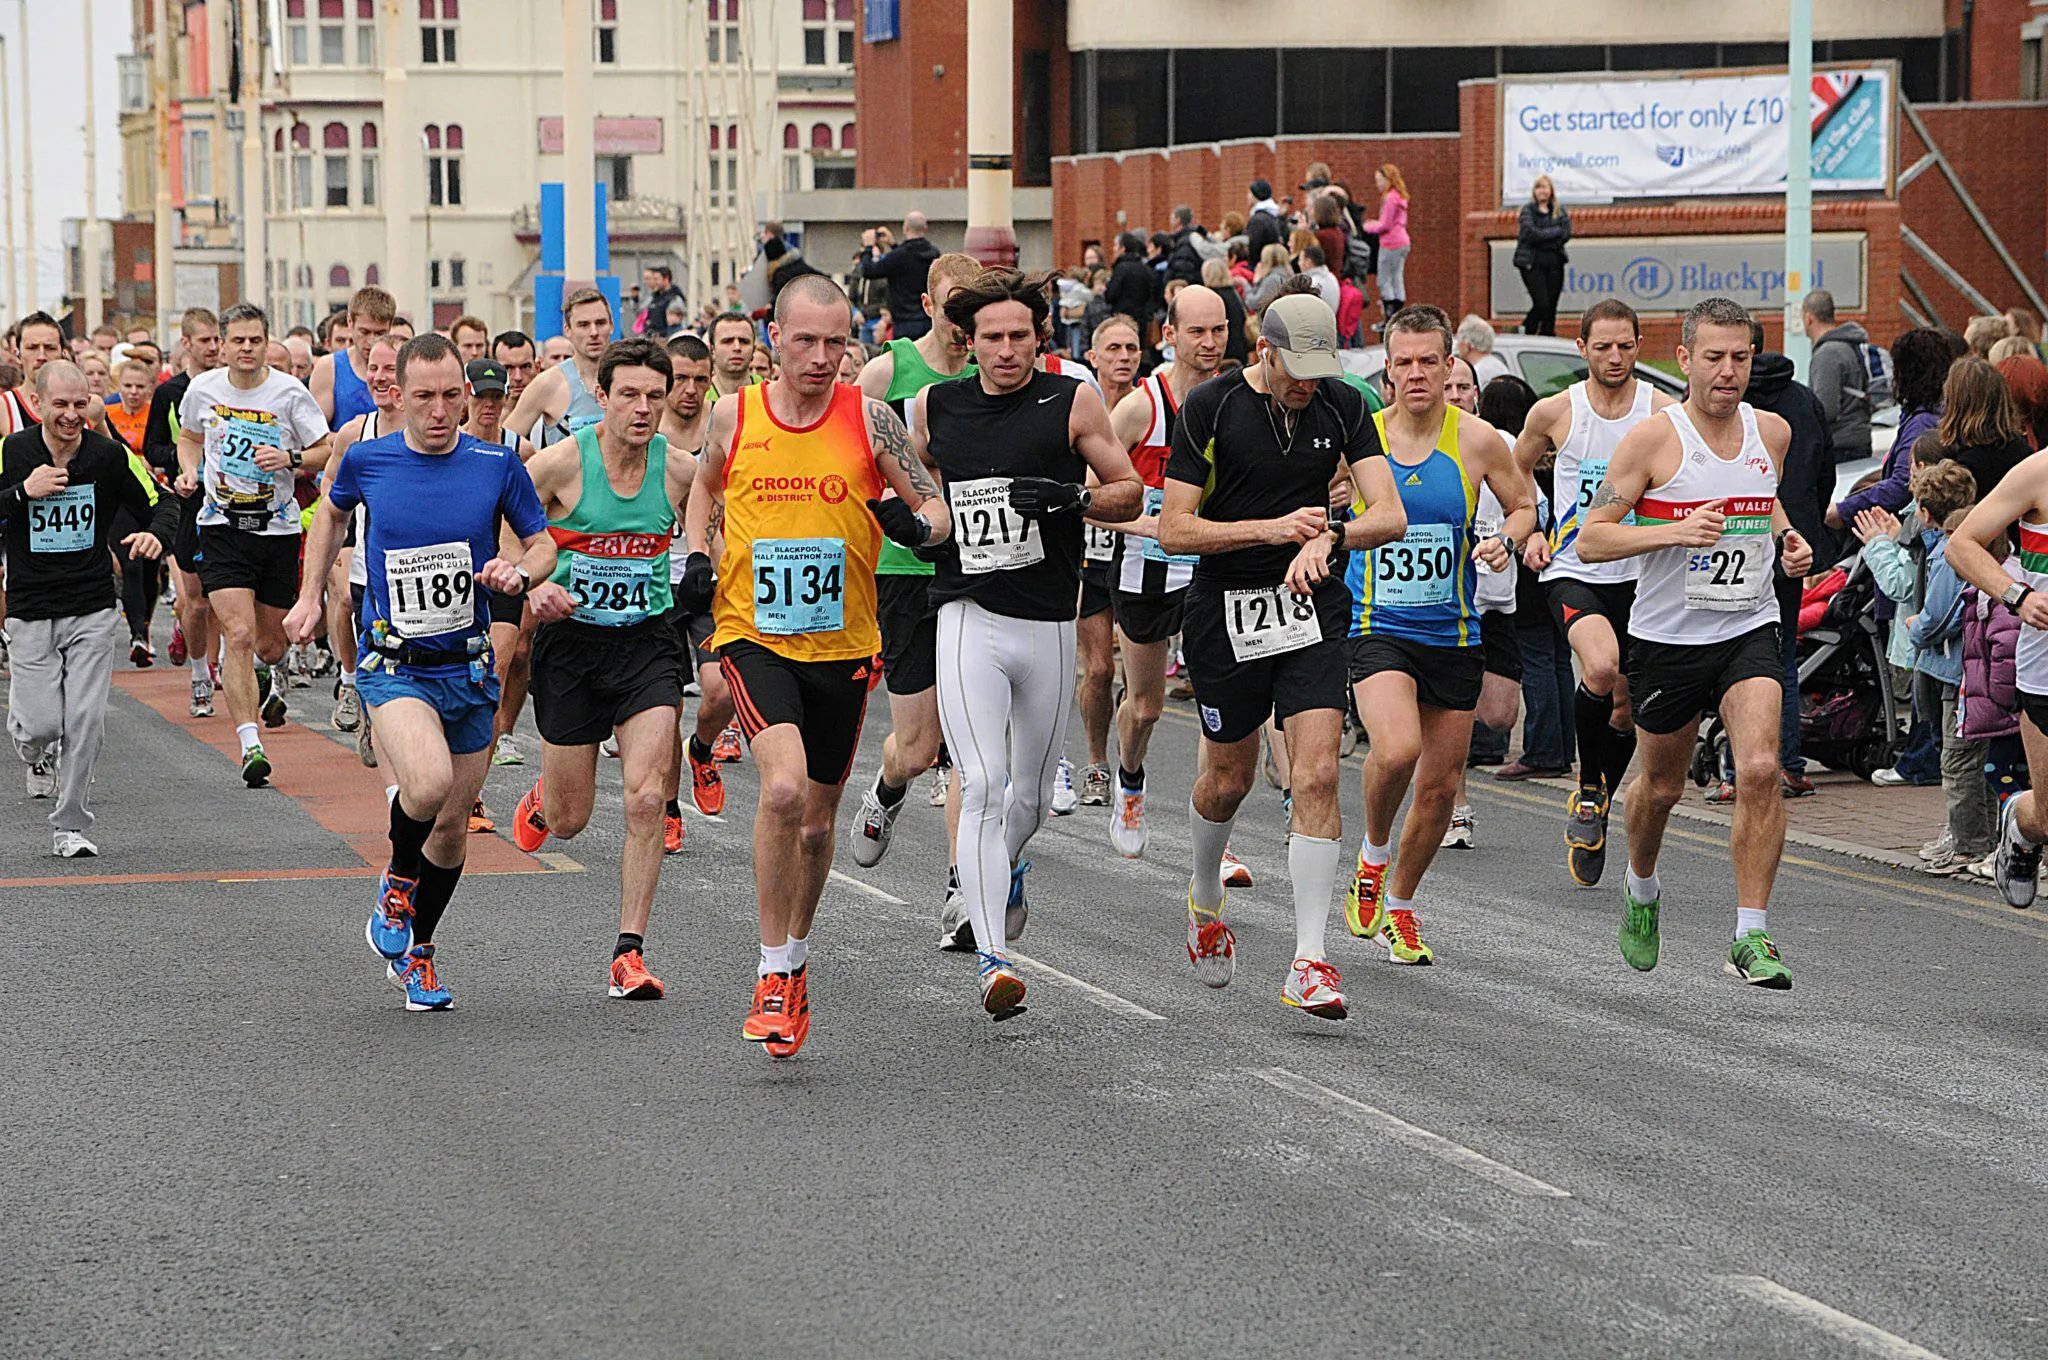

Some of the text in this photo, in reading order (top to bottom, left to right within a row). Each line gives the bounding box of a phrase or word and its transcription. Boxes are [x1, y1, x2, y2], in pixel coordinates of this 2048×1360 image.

[1519, 97, 1784, 135] Get started for only £10
[1518, 151, 1620, 172] livingwell.com
[751, 477, 817, 491] CROOK
[757, 494, 813, 502] & DISTRICT
[955, 495, 1005, 508] MARATHON
[1733, 501, 1773, 512] WALES
[32, 503, 94, 533] 5449
[588, 536, 656, 555] ERYRI
[774, 545, 822, 553] BLACKPOOL
[399, 552, 457, 566] BLACKPOOL
[776, 552, 821, 560] MARATHON
[391, 559, 470, 575] MARATHON 2012
[573, 567, 591, 575] HALF
[590, 564, 633, 572] BLACKPOOL
[1379, 546, 1453, 582] 5350
[395, 570, 472, 613] 1189
[758, 564, 843, 606] 5134
[573, 577, 648, 612] 5284
[580, 613, 596, 621] MEN
[768, 612, 786, 620] MEN
[1234, 593, 1315, 635] 1218
[1245, 637, 1263, 647] MEN
